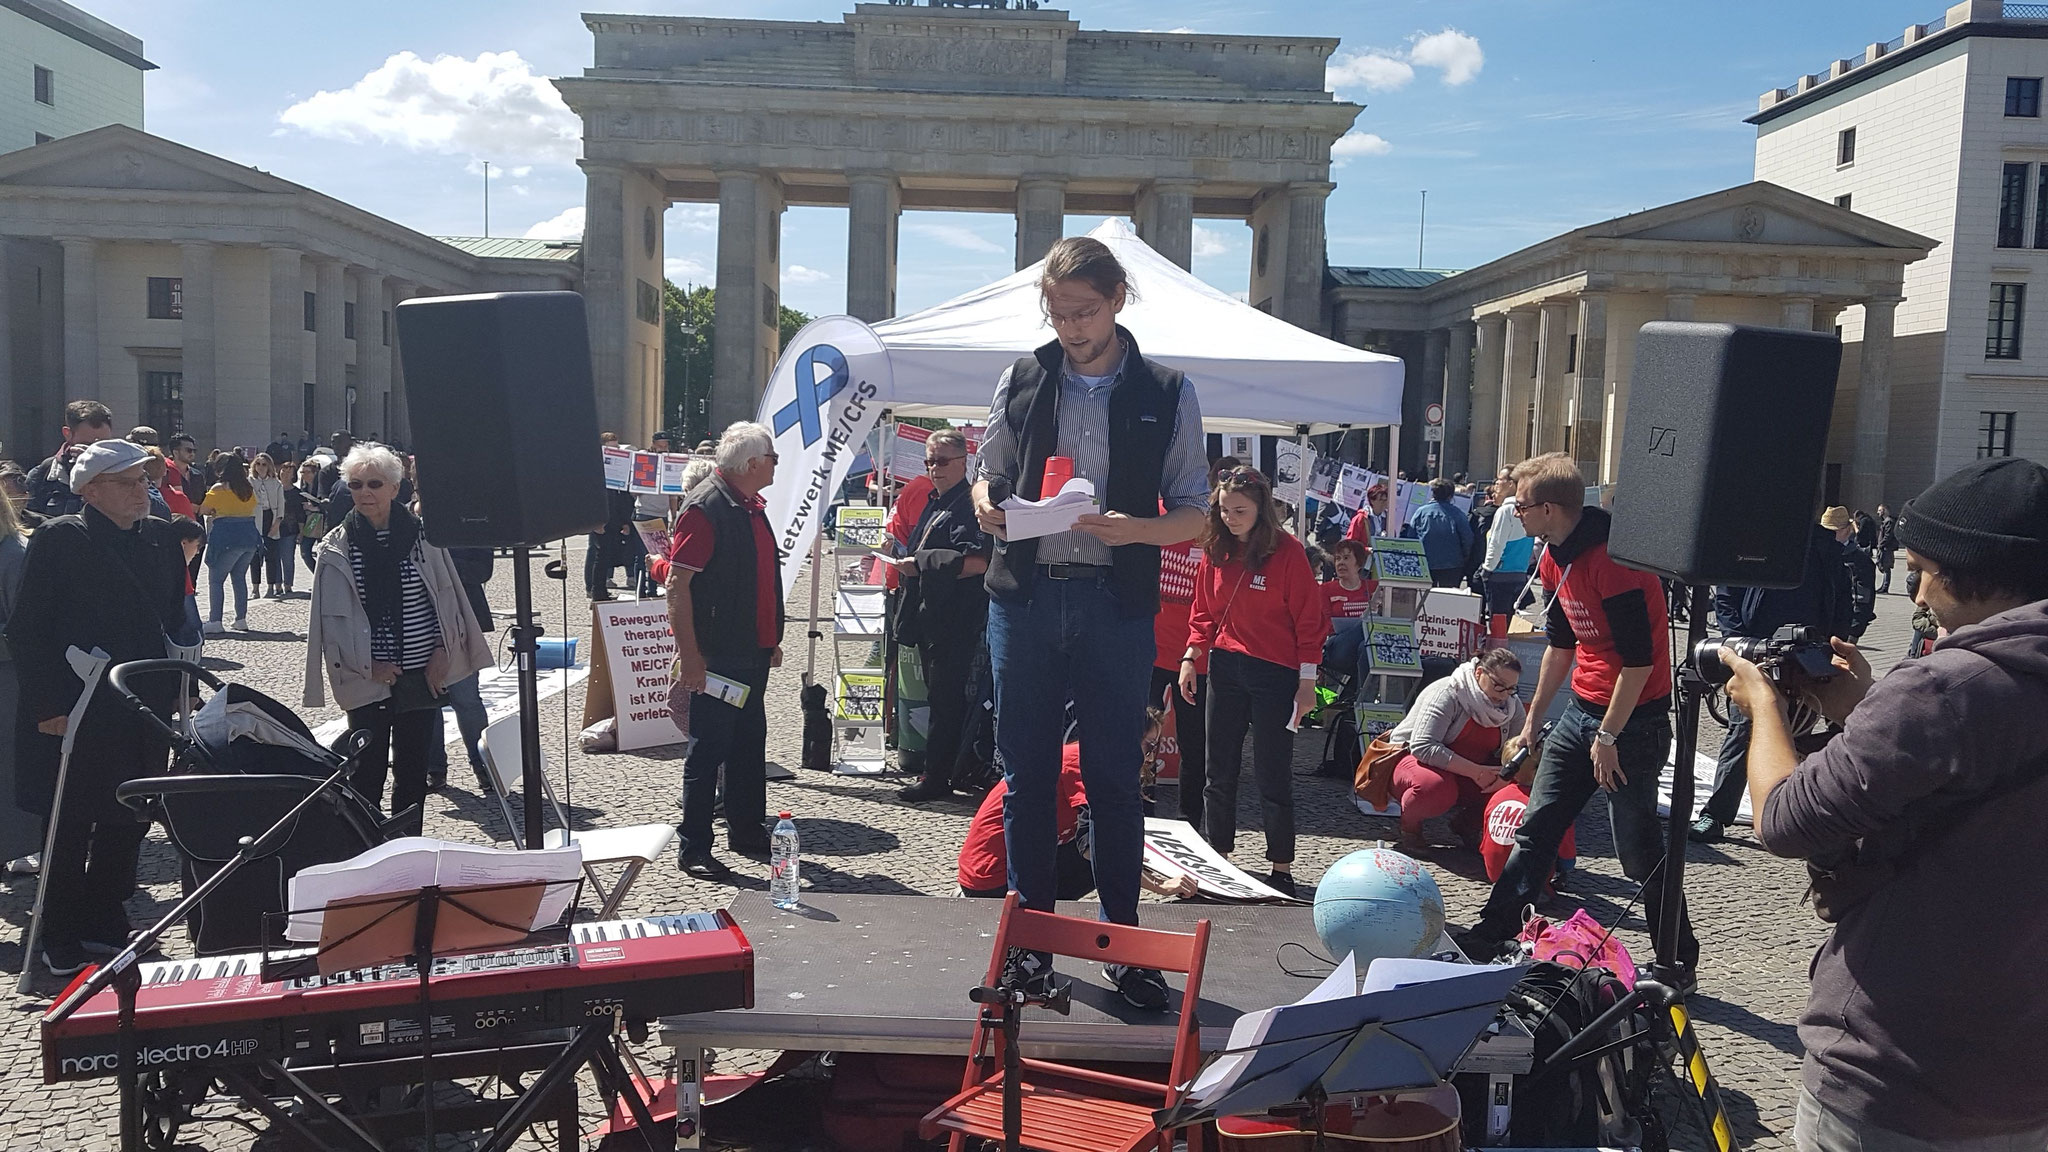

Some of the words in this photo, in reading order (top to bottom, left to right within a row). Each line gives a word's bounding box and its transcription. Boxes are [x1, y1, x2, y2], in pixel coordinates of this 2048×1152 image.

[779, 468, 831, 566] Netzwerk
[821, 380, 877, 463] ME/CFS
[1421, 625, 1446, 638] Ethik
[621, 644, 639, 657] für
[630, 658, 672, 672] ME/CF
[629, 693, 646, 705] ist
